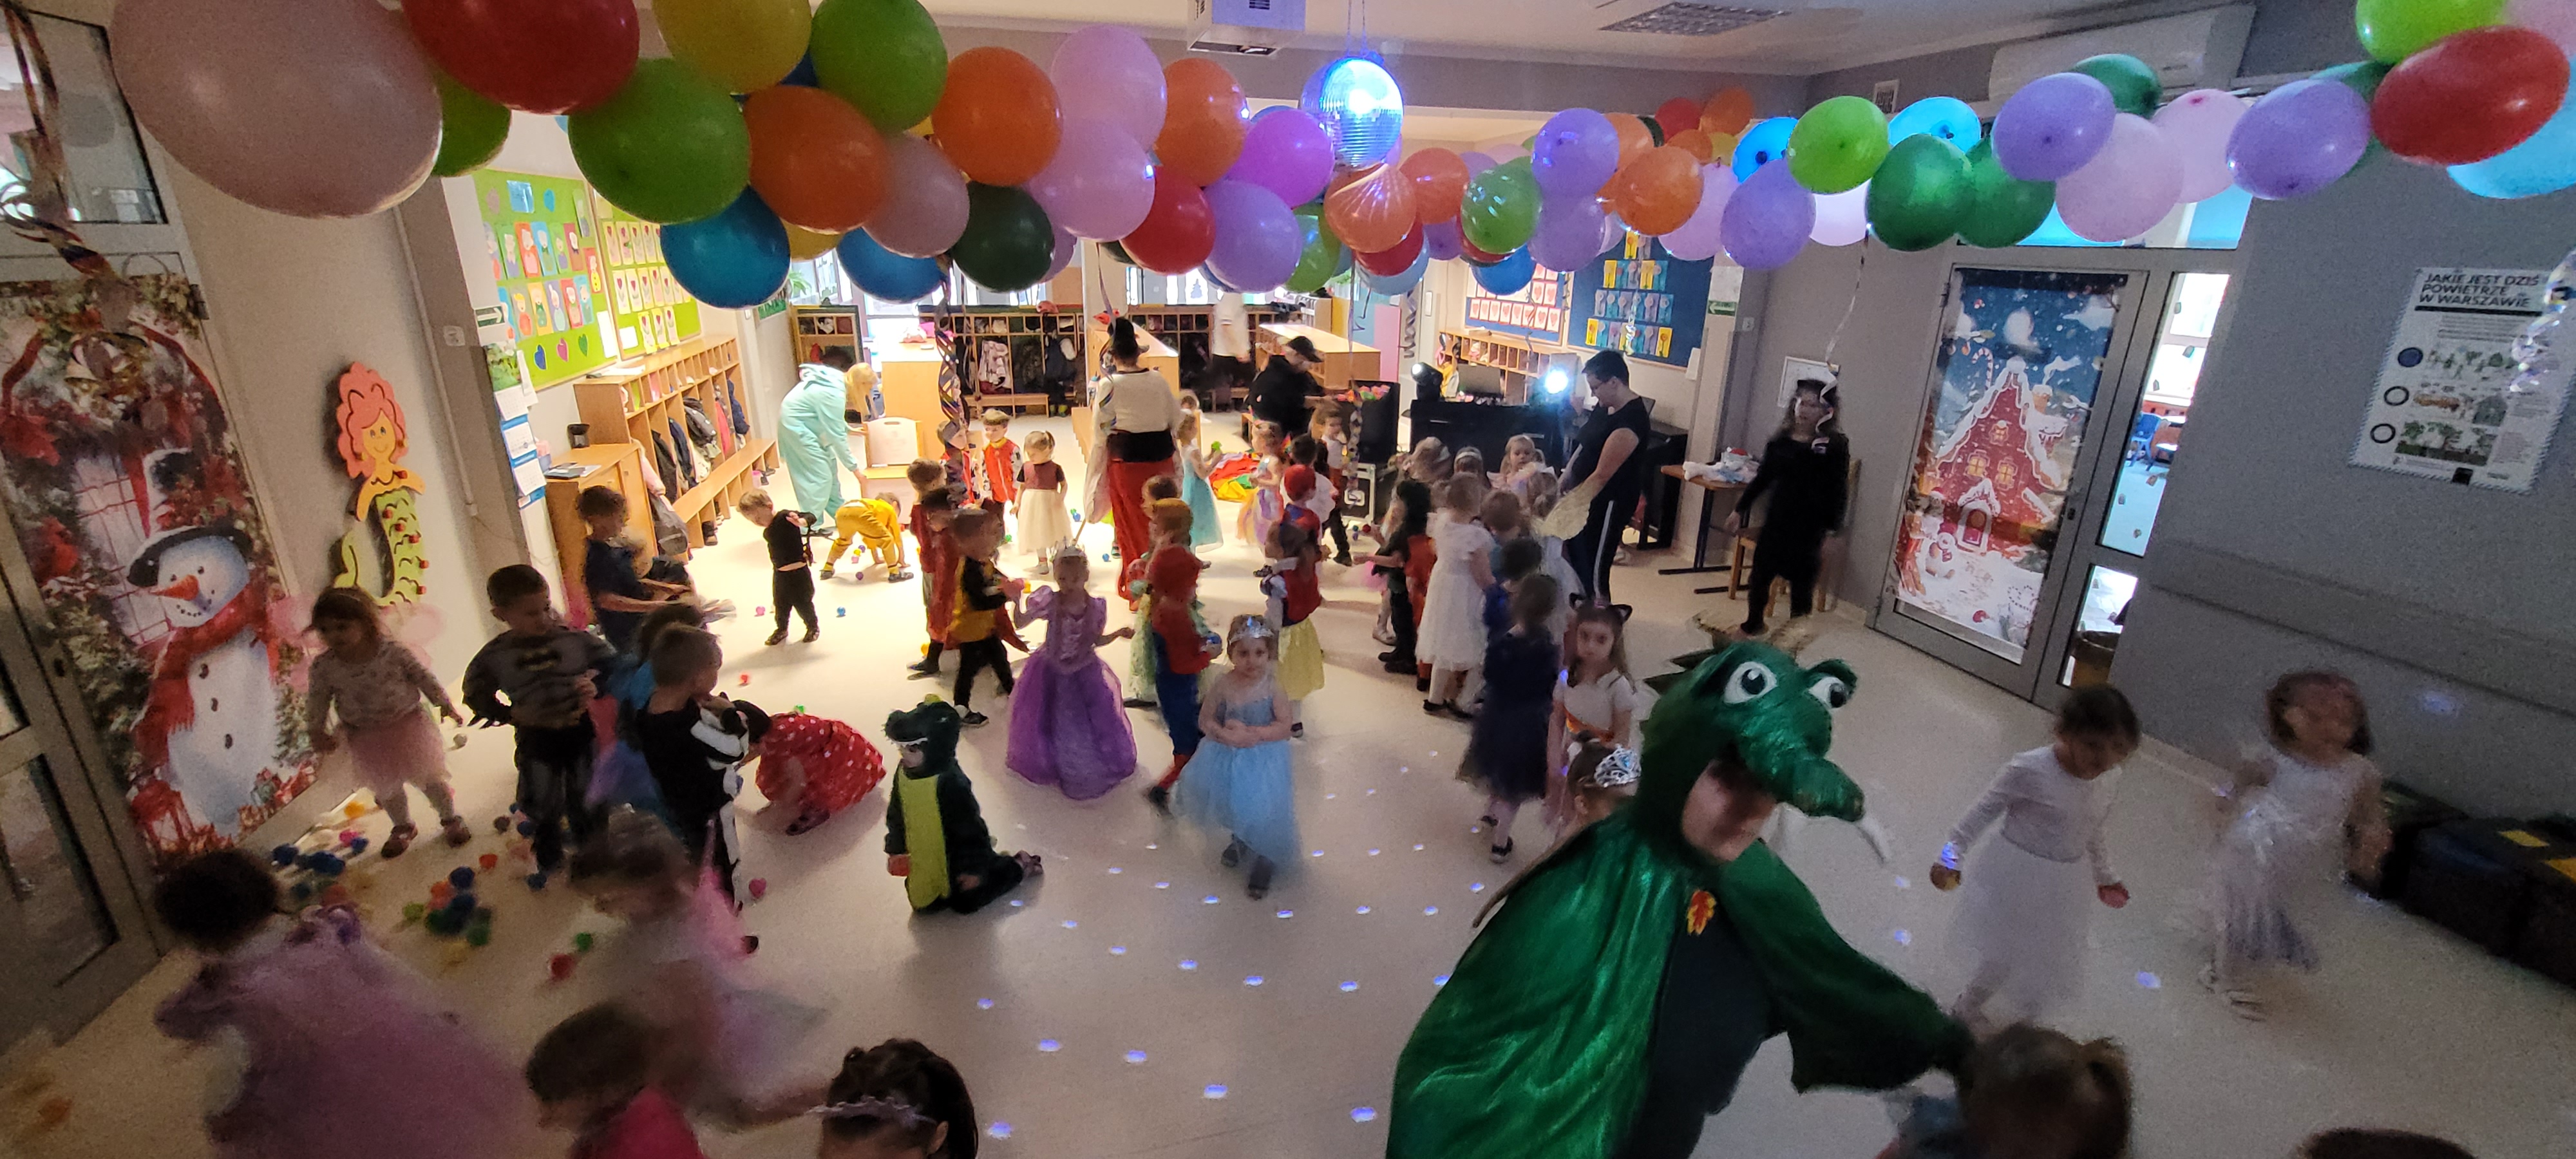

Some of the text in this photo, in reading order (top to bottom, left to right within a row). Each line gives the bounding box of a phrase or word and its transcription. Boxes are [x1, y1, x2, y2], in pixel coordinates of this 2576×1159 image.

[2425, 273, 2539, 286] JAKIE JEST DZIŚ
[2421, 284, 2509, 296] POWIETRZE
[2420, 294, 2532, 307] W WARSZAWIE
